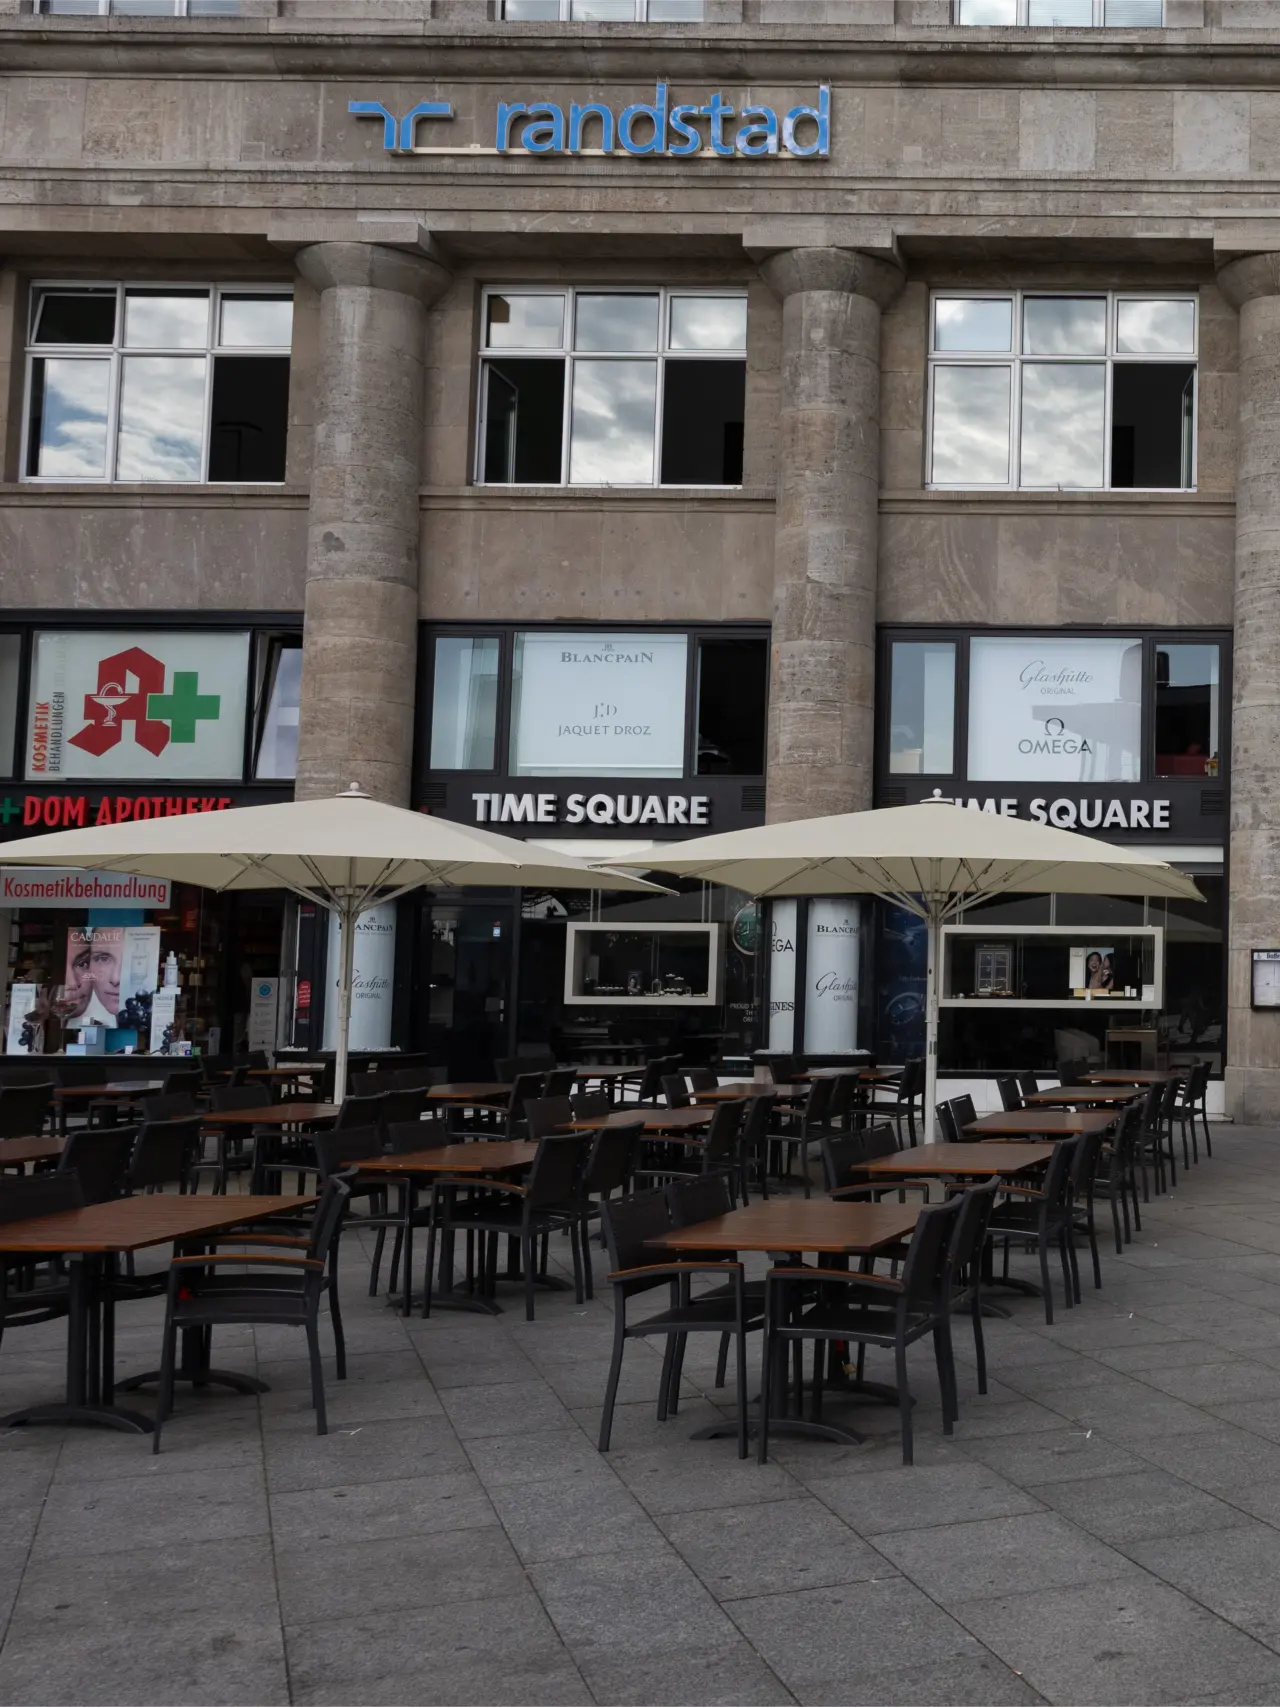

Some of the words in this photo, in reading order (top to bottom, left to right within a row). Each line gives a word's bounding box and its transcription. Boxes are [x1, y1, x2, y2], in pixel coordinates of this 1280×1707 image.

[497, 82, 831, 156] randstad
[560, 652, 654, 664] BLANCPAIN
[1040, 687, 1075, 695] ORIGINAL
[32, 702, 49, 772] KOSMETIK
[49, 691, 64, 772] BEHANDLUNGEN
[558, 725, 609, 736] JAQUET
[614, 725, 651, 736] DROZ
[1018, 739, 1092, 754] OMEGA
[23, 796, 87, 827] DOM
[472, 793, 557, 823] TIME
[566, 793, 710, 826] SQUARE
[1029, 798, 1170, 829] SQUARE
[4, 876, 167, 903] Kosmetikbehandlung
